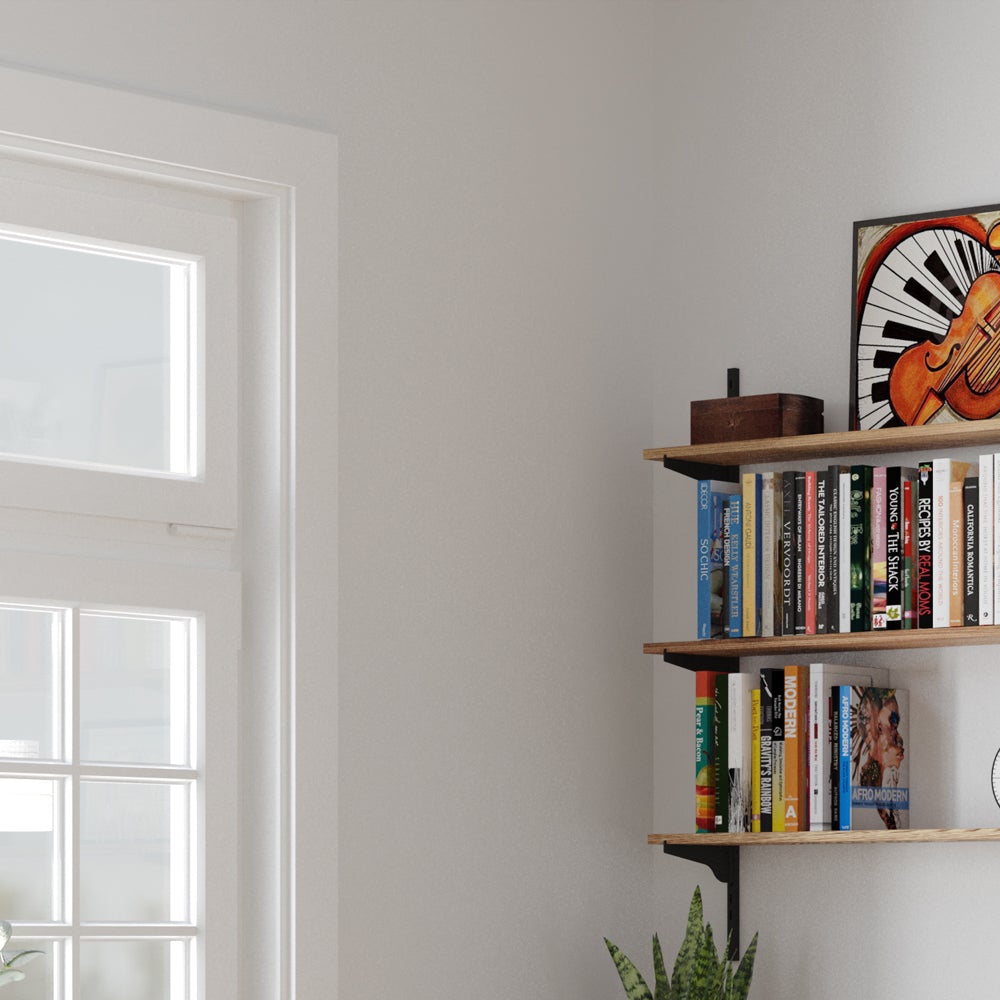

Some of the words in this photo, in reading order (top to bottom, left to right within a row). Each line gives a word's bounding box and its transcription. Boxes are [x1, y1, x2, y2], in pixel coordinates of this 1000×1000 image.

[731, 501, 739, 524] HUE
[889, 487, 899, 522] YOUNG
[919, 498, 930, 537] RECIPES
[700, 539, 708, 554] SO
[731, 534, 739, 561] KELLY
[888, 532, 899, 553] THE
[919, 540, 930, 552] BY
[700, 556, 708, 580] CHIC
[888, 556, 899, 591] SHACK
[919, 555, 930, 578] REAL
[731, 565, 739, 617] WEARSTLER
[919, 582, 930, 615] MOMS
[785, 676, 796, 738] MODERN
[761, 736, 771, 775] GRAVITY'S
[761, 777, 771, 814] RAINBOW
[852, 789, 874, 802] AFRO
[875, 788, 908, 802] MODERN
